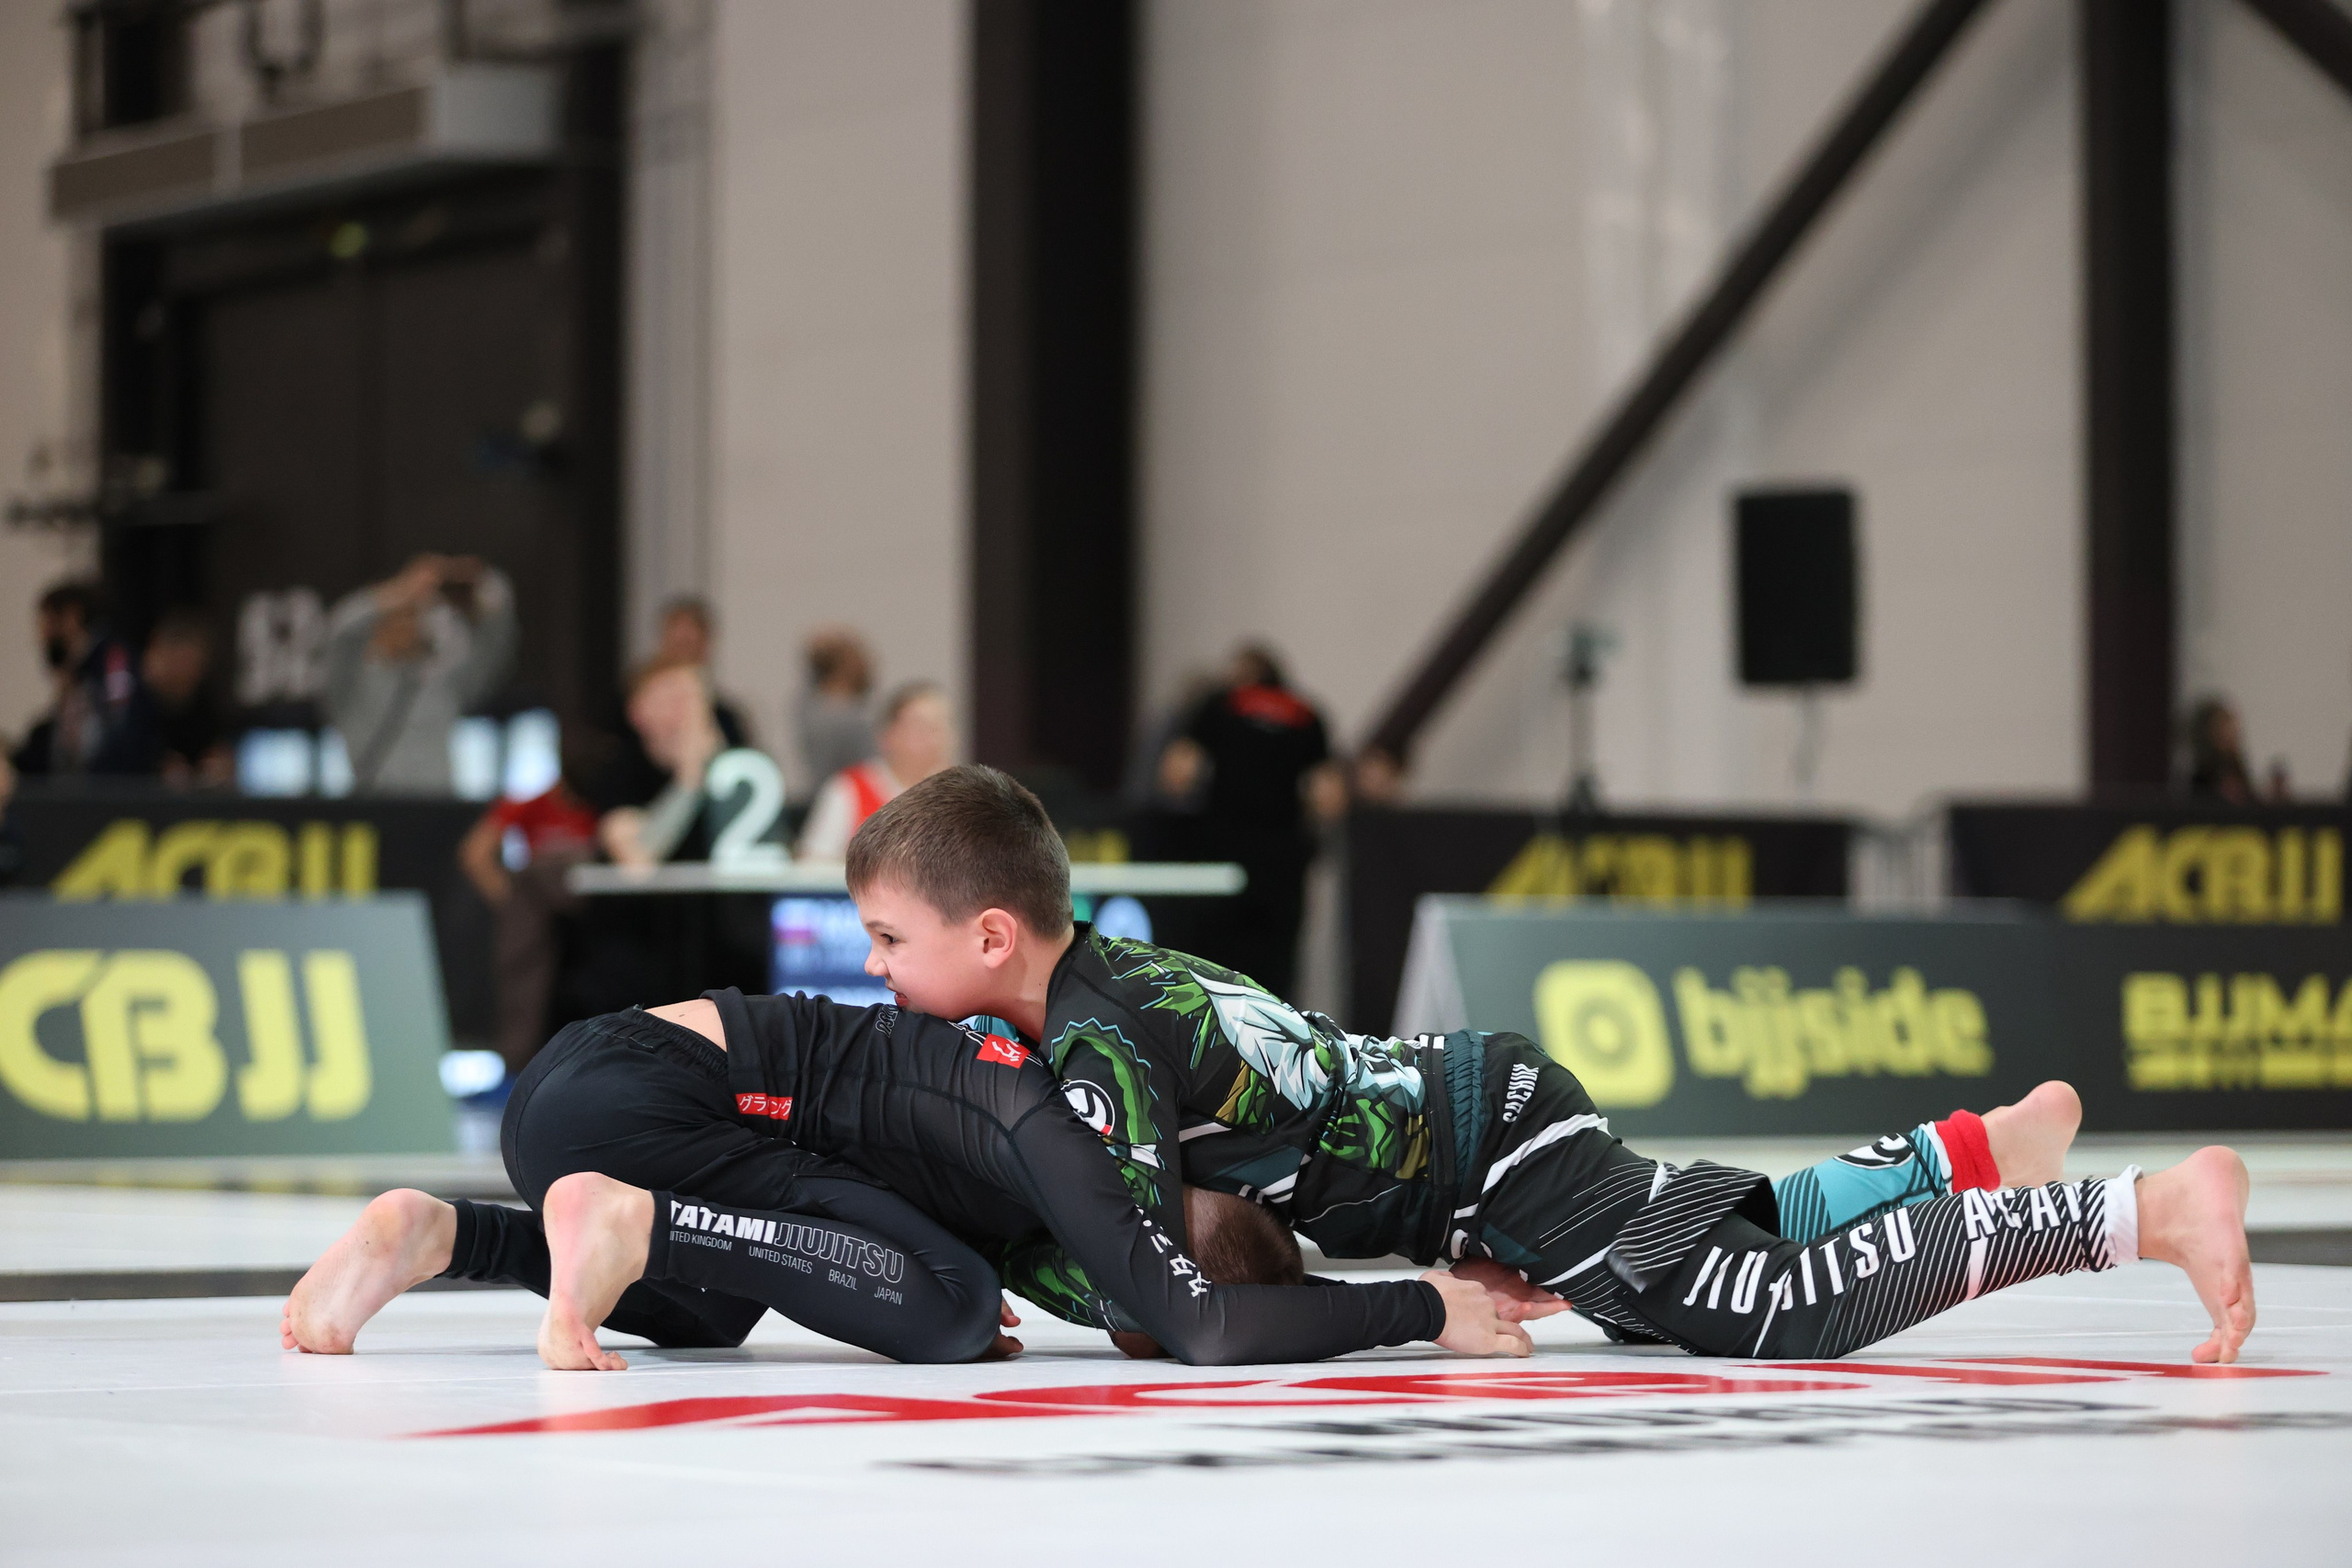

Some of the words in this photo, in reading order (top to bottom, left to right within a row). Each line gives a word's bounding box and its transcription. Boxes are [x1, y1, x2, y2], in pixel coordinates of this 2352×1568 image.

[707, 748, 792, 874] 2
[692, 1234, 733, 1251] KINGDOM
[749, 1246, 780, 1264] UNITED
[781, 1254, 813, 1274] STATES
[828, 1269, 858, 1291] BRAZIL
[874, 1286, 902, 1305] JAPAN
